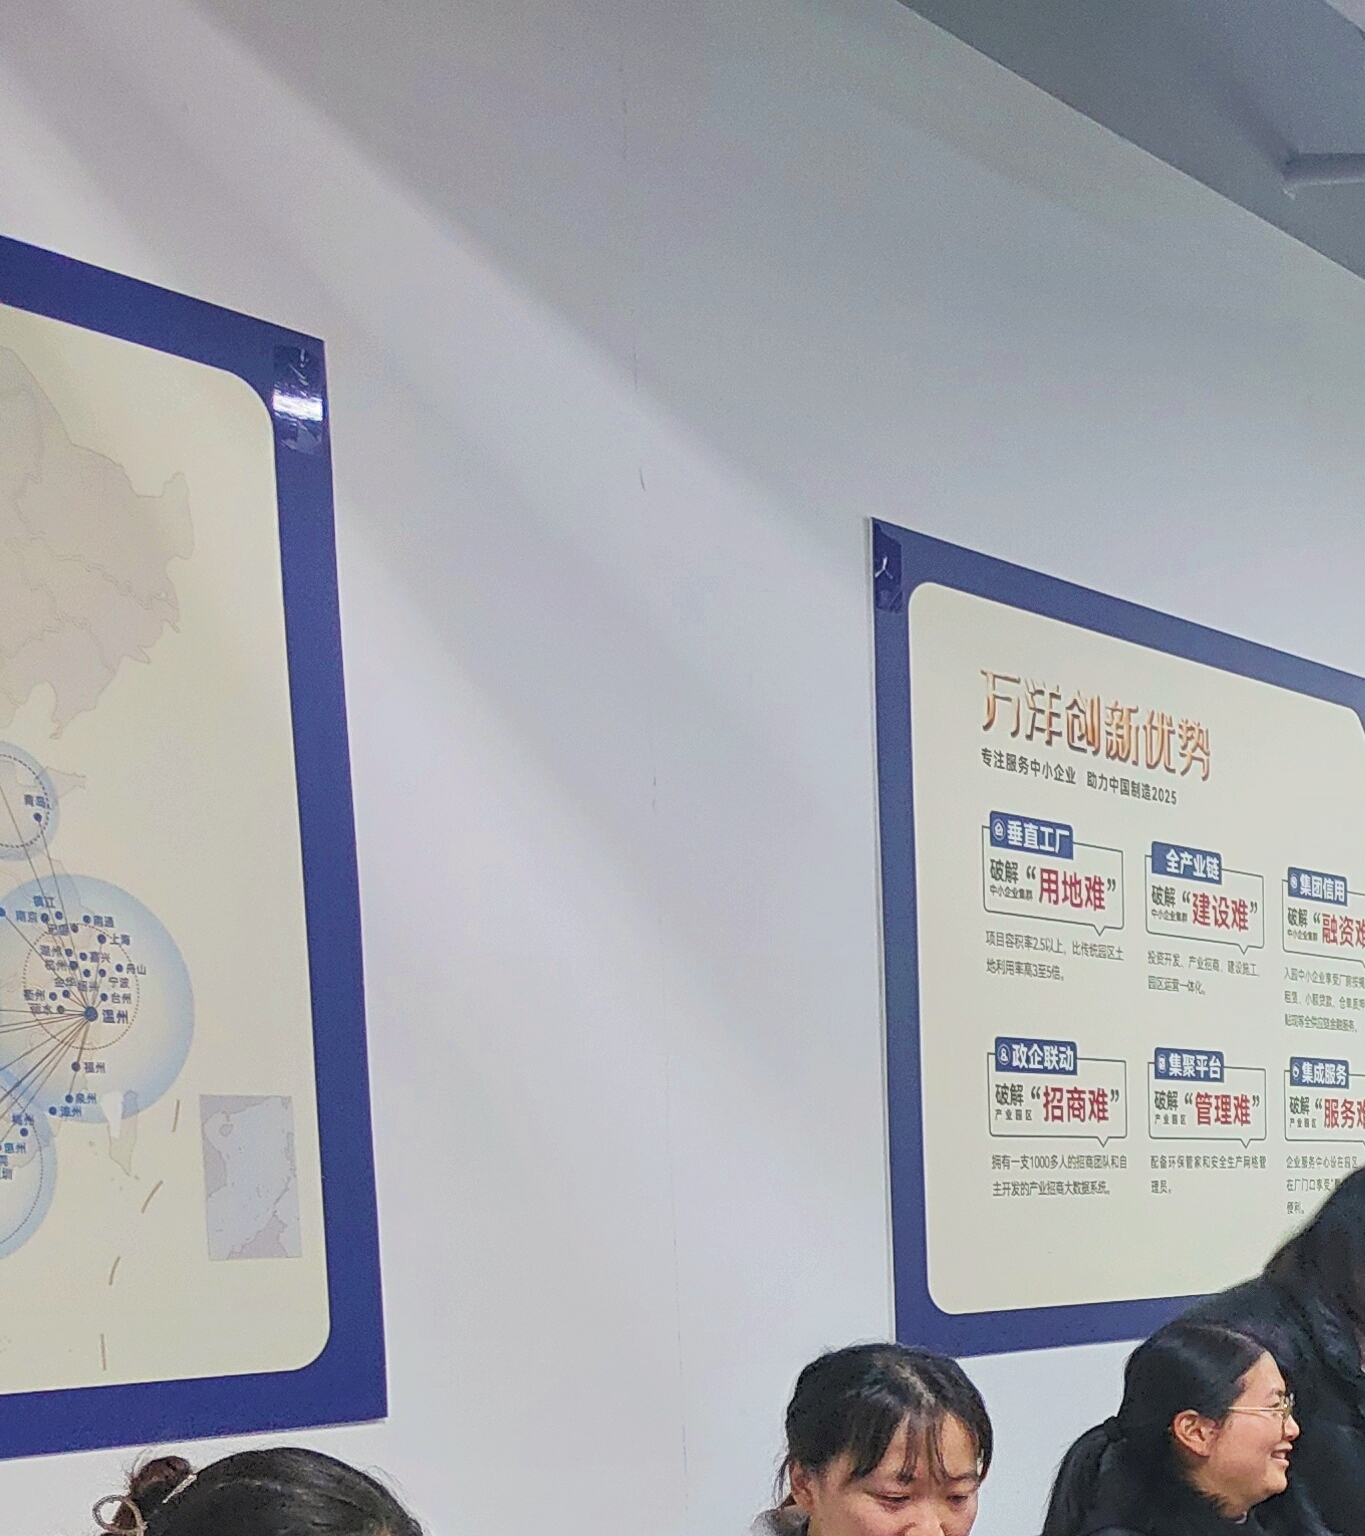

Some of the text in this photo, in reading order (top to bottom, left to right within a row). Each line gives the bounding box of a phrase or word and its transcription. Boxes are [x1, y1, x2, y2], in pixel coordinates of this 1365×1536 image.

[980, 669, 1211, 781] 万洋创新优势
[981, 747, 1177, 805] 专注服务中小企业 助力中国制造2025
[1006, 820, 1070, 853] 垂直工厂
[1165, 849, 1220, 881] 全产业链
[989, 859, 1116, 911] 破解 “用地难”
[989, 884, 1033, 901] 中小企业集群
[1299, 873, 1345, 903] 集团信用
[1151, 885, 1258, 932] 破解 “建设难”
[1151, 908, 1188, 923] 中小企业集群
[1287, 907, 1308, 928] 破解
[109, 933, 131, 946] 上海
[111, 992, 132, 1005] 台州
[102, 1009, 129, 1025] 温州
[1011, 1043, 1074, 1072] 政企联动
[1169, 1053, 1222, 1079] 集聚平台
[1301, 1061, 1347, 1086] 集成服务
[995, 1083, 1120, 1124] 破解 “招商难”
[995, 1108, 1032, 1121] 产业园区
[1154, 1090, 1260, 1126] 破解 “管理难”
[1289, 1096, 1310, 1115] 破解
[1154, 1114, 1187, 1125] 产业园区
[992, 1154, 1127, 1170] 拥有一支1000多人的招商团队和自
